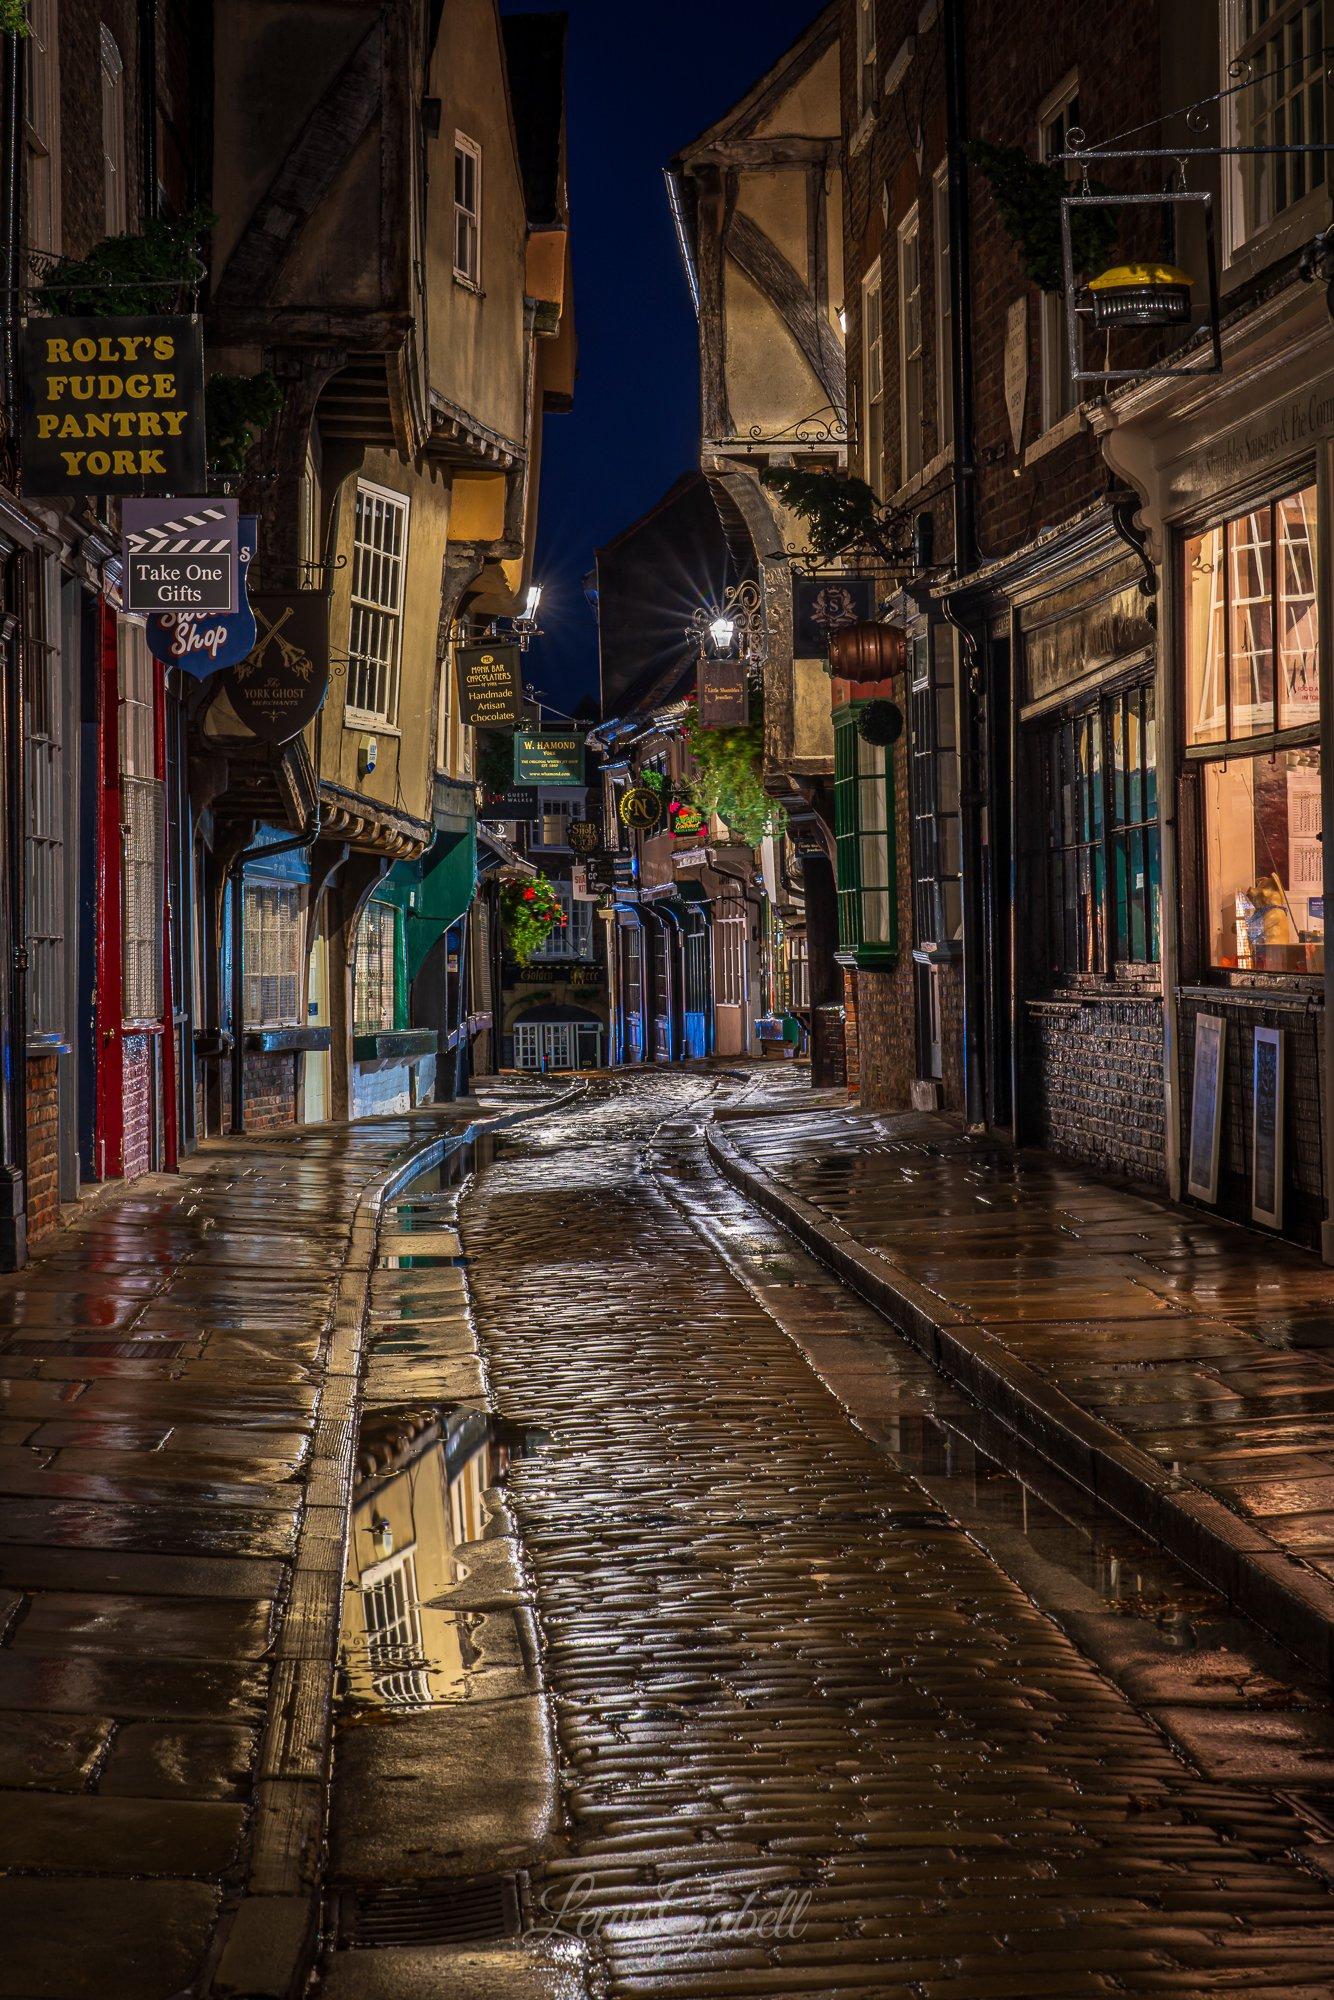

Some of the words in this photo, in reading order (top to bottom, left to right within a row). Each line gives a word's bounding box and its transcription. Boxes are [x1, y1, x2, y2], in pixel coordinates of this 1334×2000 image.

[45, 335, 176, 363] ROLY'S
[46, 373, 177, 401] FUDGE
[37, 410, 188, 439] PANTRY
[1280, 407, 1288, 445] &
[1292, 398, 1306, 441] Pie
[60, 449, 167, 477] YORK
[136, 564, 181, 581] Take
[186, 564, 223, 581] One
[157, 584, 202, 602] Gifts
[171, 622, 228, 658] Shop
[471, 665, 490, 674] MONK
[491, 664, 505, 673] BAR
[466, 672, 511, 684] CHOCOLATIERS
[244, 688, 270, 698] YORK
[272, 688, 305, 699] GHOST
[468, 689, 513, 700] Handmade
[477, 702, 506, 711] Artisan
[470, 712, 515, 723] Chocolates
[524, 740, 535, 750] W.
[537, 741, 576, 750] HAMOND
[628, 798, 654, 819] N
